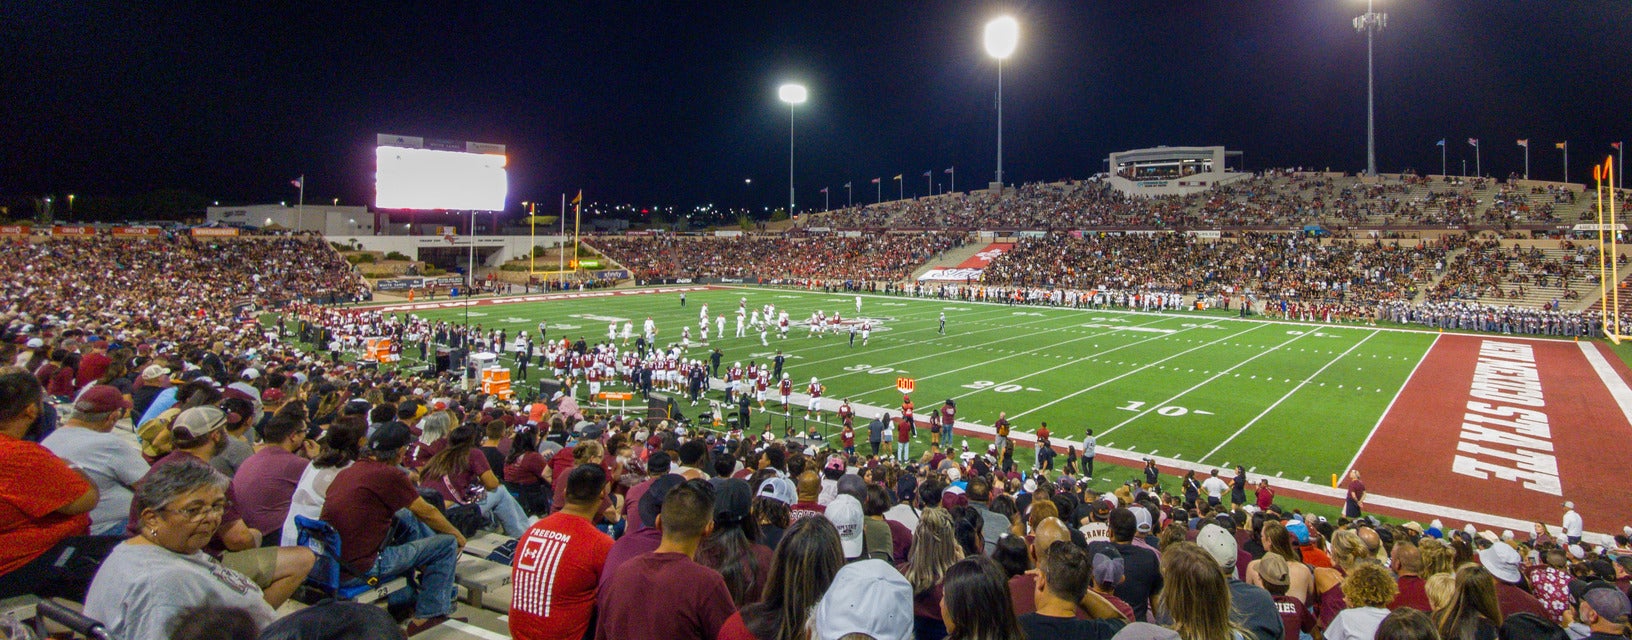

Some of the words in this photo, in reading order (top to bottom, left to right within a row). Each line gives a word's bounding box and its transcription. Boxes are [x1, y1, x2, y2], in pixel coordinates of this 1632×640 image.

[1478, 340, 1536, 362] NEW
[844, 364, 894, 374] 30
[961, 380, 1022, 392] 20
[1469, 357, 1545, 407] MEXICO
[1116, 400, 1188, 416] 10
[1452, 400, 1562, 496] STATE
[530, 528, 571, 543] FREEDOM
[378, 587, 388, 597] 23
